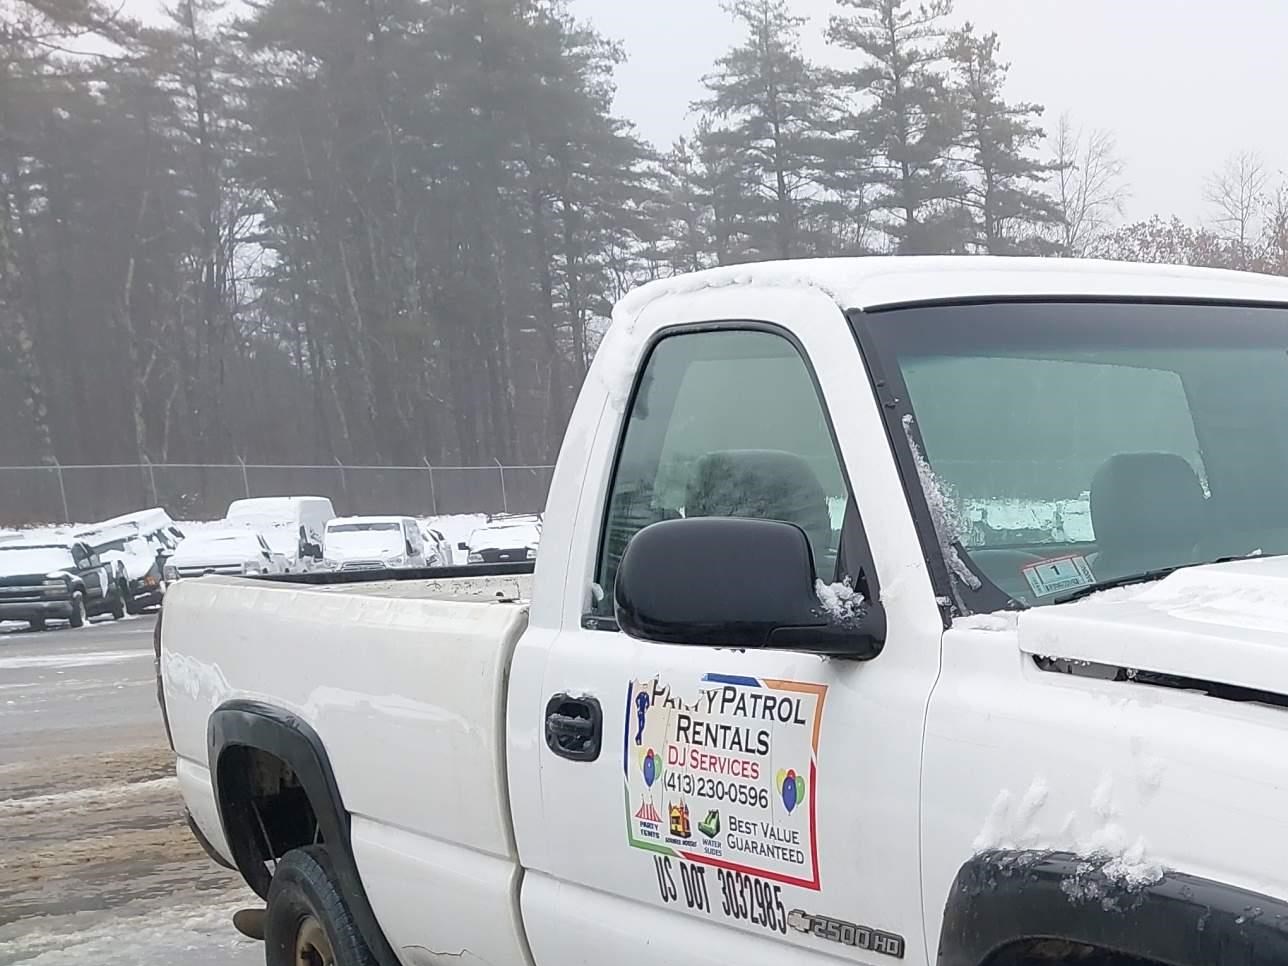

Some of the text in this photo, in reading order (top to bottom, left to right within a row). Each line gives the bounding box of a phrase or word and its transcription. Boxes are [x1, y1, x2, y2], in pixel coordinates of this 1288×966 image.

[720, 686, 806, 725] PATROL
[676, 714, 770, 756] RENTALS
[668, 745, 760, 779] DJ SERVICES
[663, 769, 769, 809] (413) 230-0596
[640, 820, 658, 830] PARTY
[729, 815, 800, 845] BEST VALUE
[702, 839, 721, 849] WATER
[726, 833, 805, 865] GUARANTEED
[653, 854, 787, 935] US DOT 3032985
